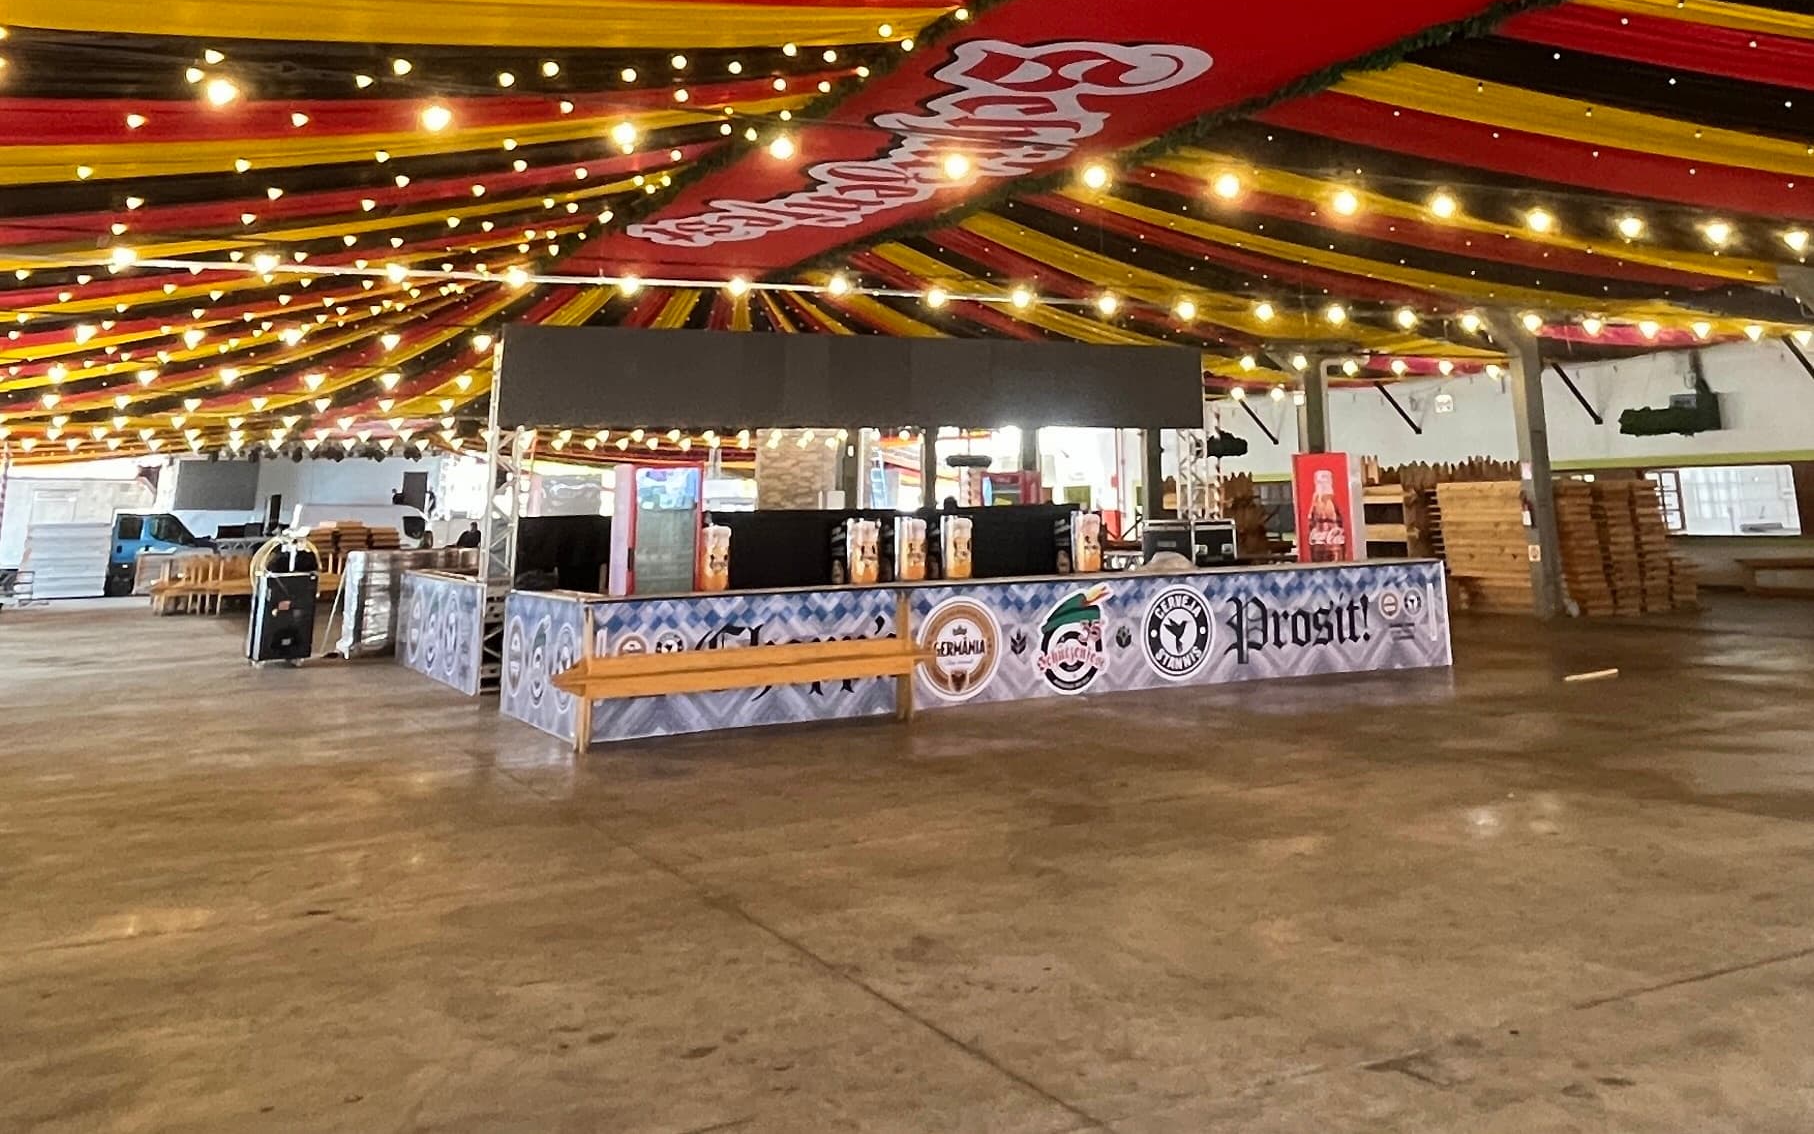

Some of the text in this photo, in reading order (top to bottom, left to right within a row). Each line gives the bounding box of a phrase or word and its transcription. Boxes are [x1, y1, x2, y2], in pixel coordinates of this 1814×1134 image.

[1155, 595, 1201, 618] CERVEJA
[1224, 593, 1371, 664] Prosit!
[1155, 646, 1202, 670] STANNIS
